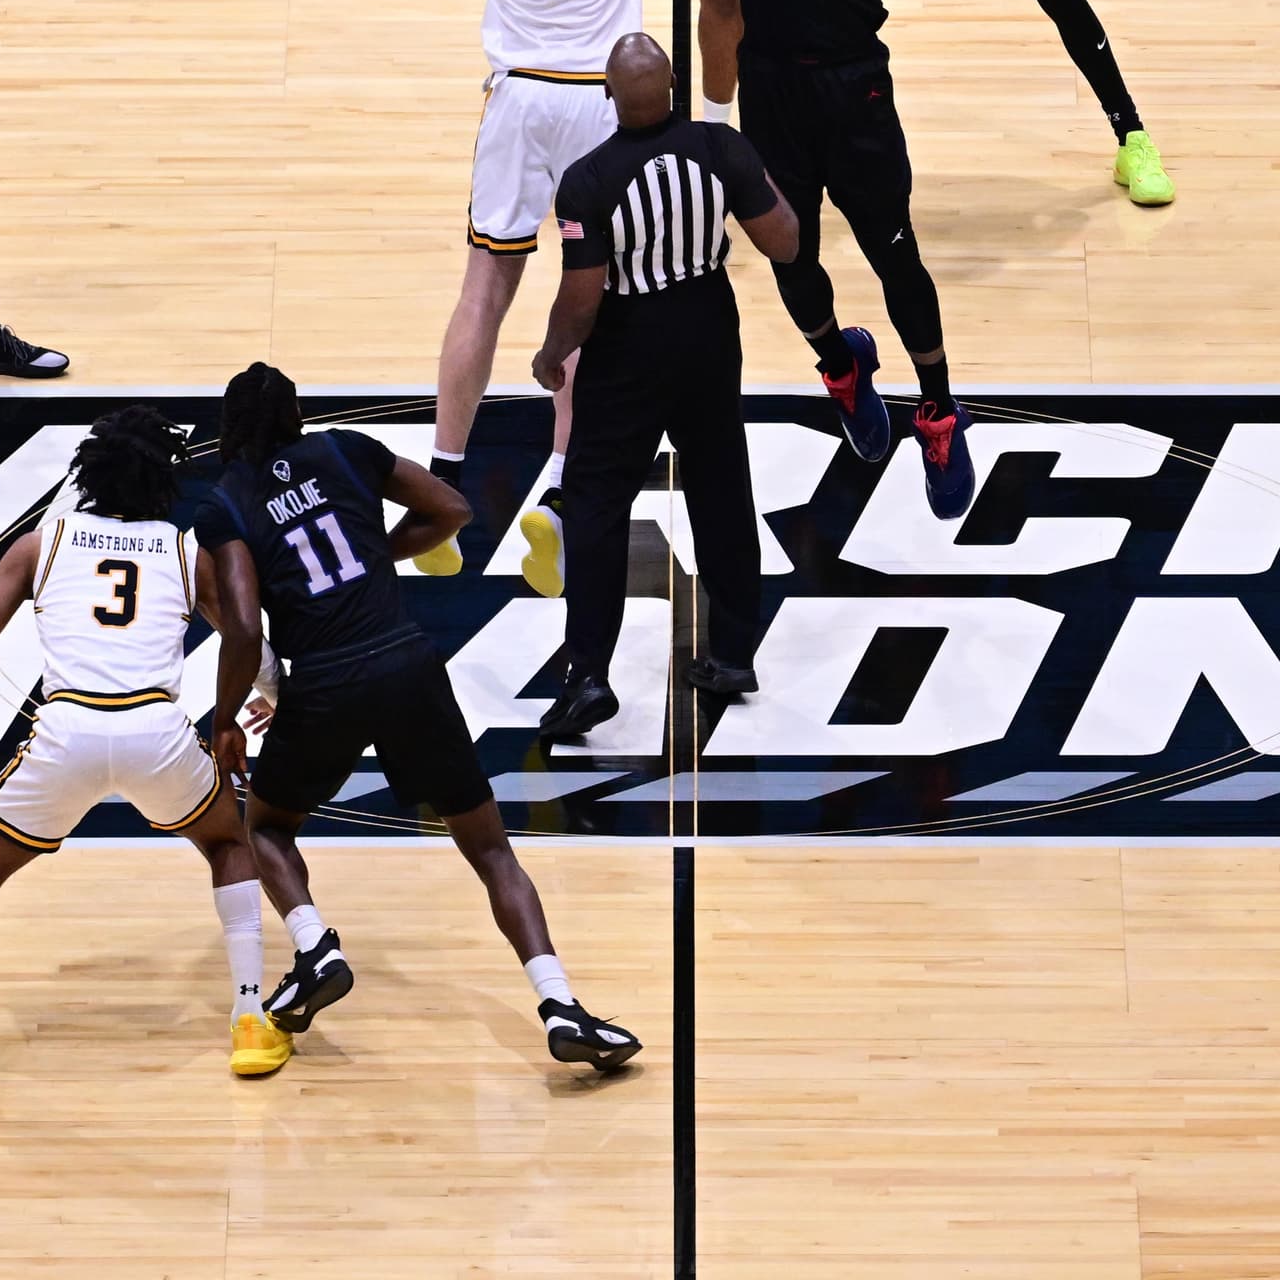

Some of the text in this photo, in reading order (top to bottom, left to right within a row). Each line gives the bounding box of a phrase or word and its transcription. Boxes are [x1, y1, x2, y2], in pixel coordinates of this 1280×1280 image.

[266, 478, 329, 526] OKOJIE
[71, 531, 168, 555] ARMSTRONG JR.
[283, 510, 367, 596] 11
[91, 557, 140, 630] 3
